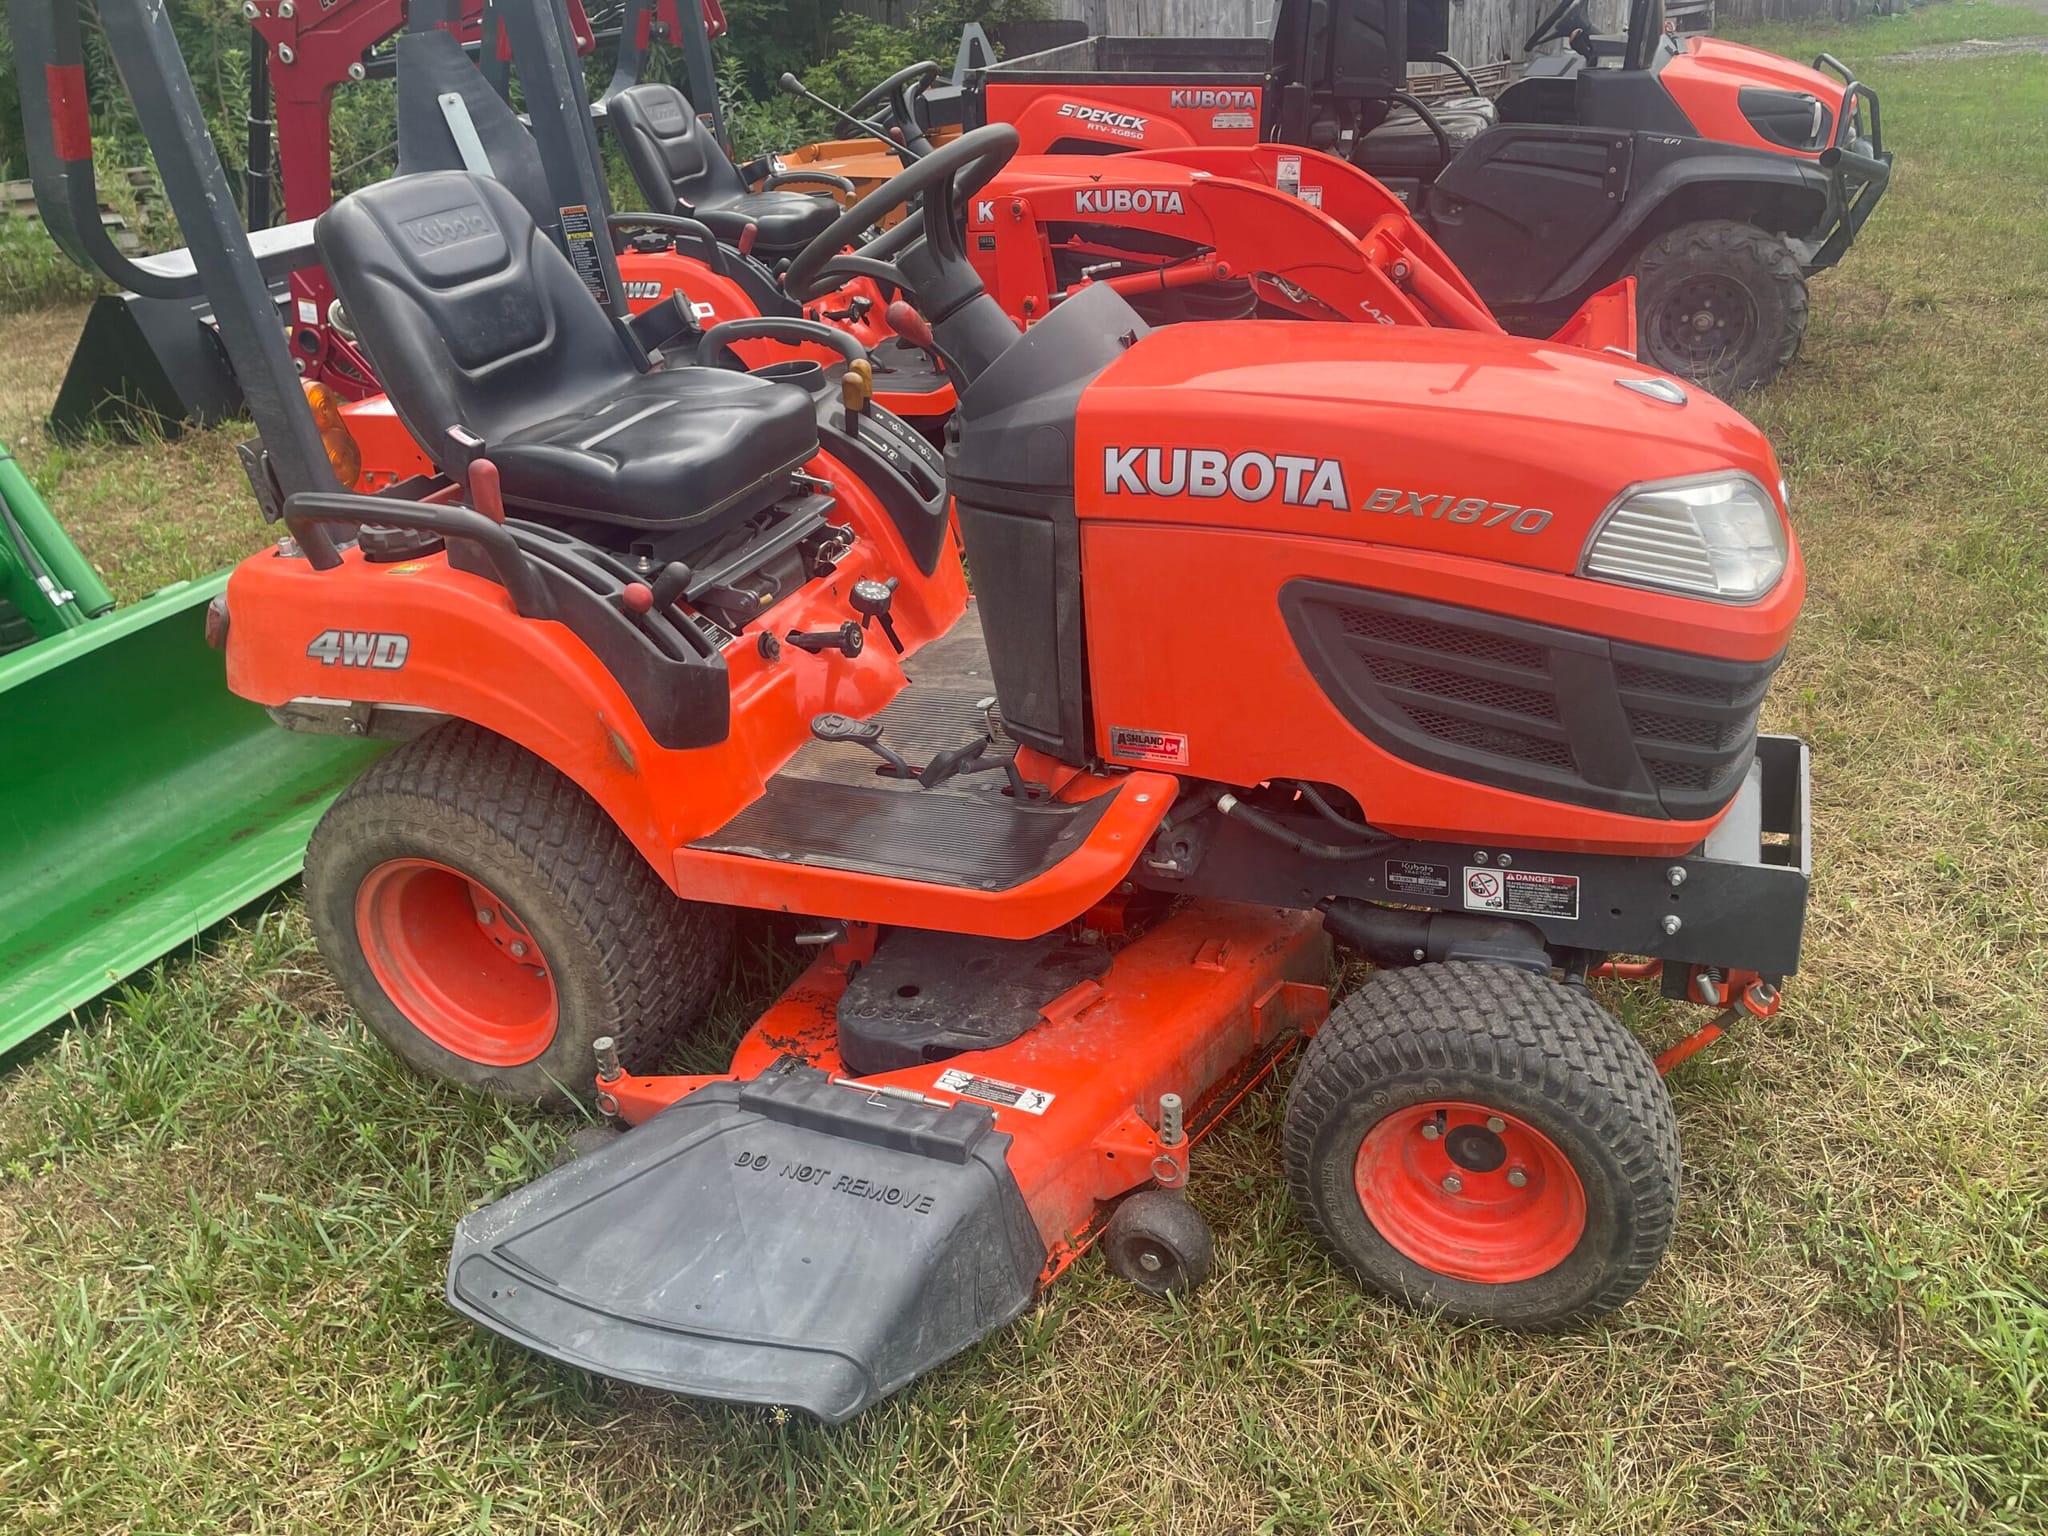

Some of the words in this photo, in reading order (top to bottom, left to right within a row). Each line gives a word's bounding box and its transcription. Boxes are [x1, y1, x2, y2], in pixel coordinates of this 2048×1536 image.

[1170, 90, 1257, 110] KUBOTA
[1075, 190, 1184, 214] KUBOTA
[1104, 446, 1351, 511] KUBOTA
[1361, 487, 1554, 534] BX1870
[306, 629, 410, 670] 4WD
[1118, 733, 1163, 746] ASHLAND
[1401, 862, 1434, 873] Kubota
[1516, 874, 1554, 883] DANGER
[735, 1152, 770, 1171] DO
[780, 1162, 831, 1186] NOT
[833, 1176, 935, 1214] REMOVE
